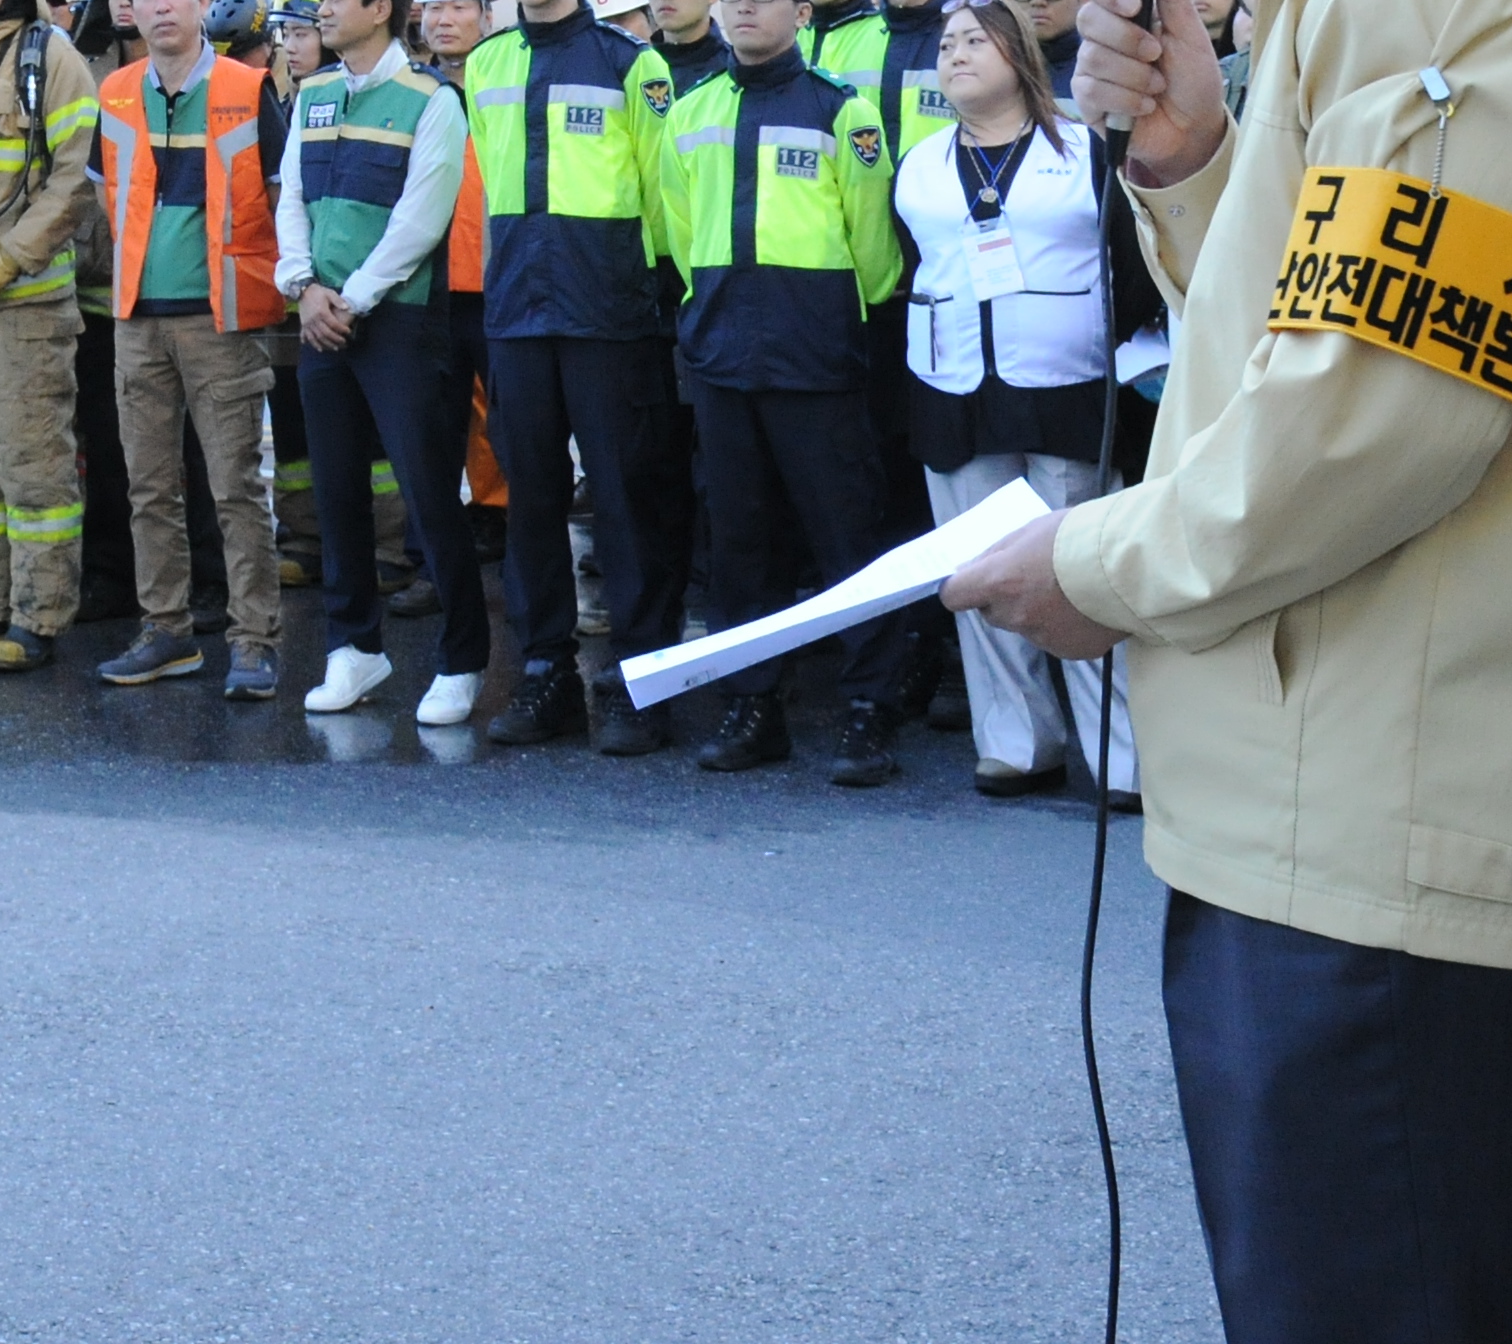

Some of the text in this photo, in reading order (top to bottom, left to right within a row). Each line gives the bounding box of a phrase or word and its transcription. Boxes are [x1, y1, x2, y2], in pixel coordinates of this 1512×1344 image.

[569, 107, 601, 124] 112
[566, 124, 602, 134] POLICE
[780, 148, 816, 168] 112
[777, 166, 817, 179] POLICE
